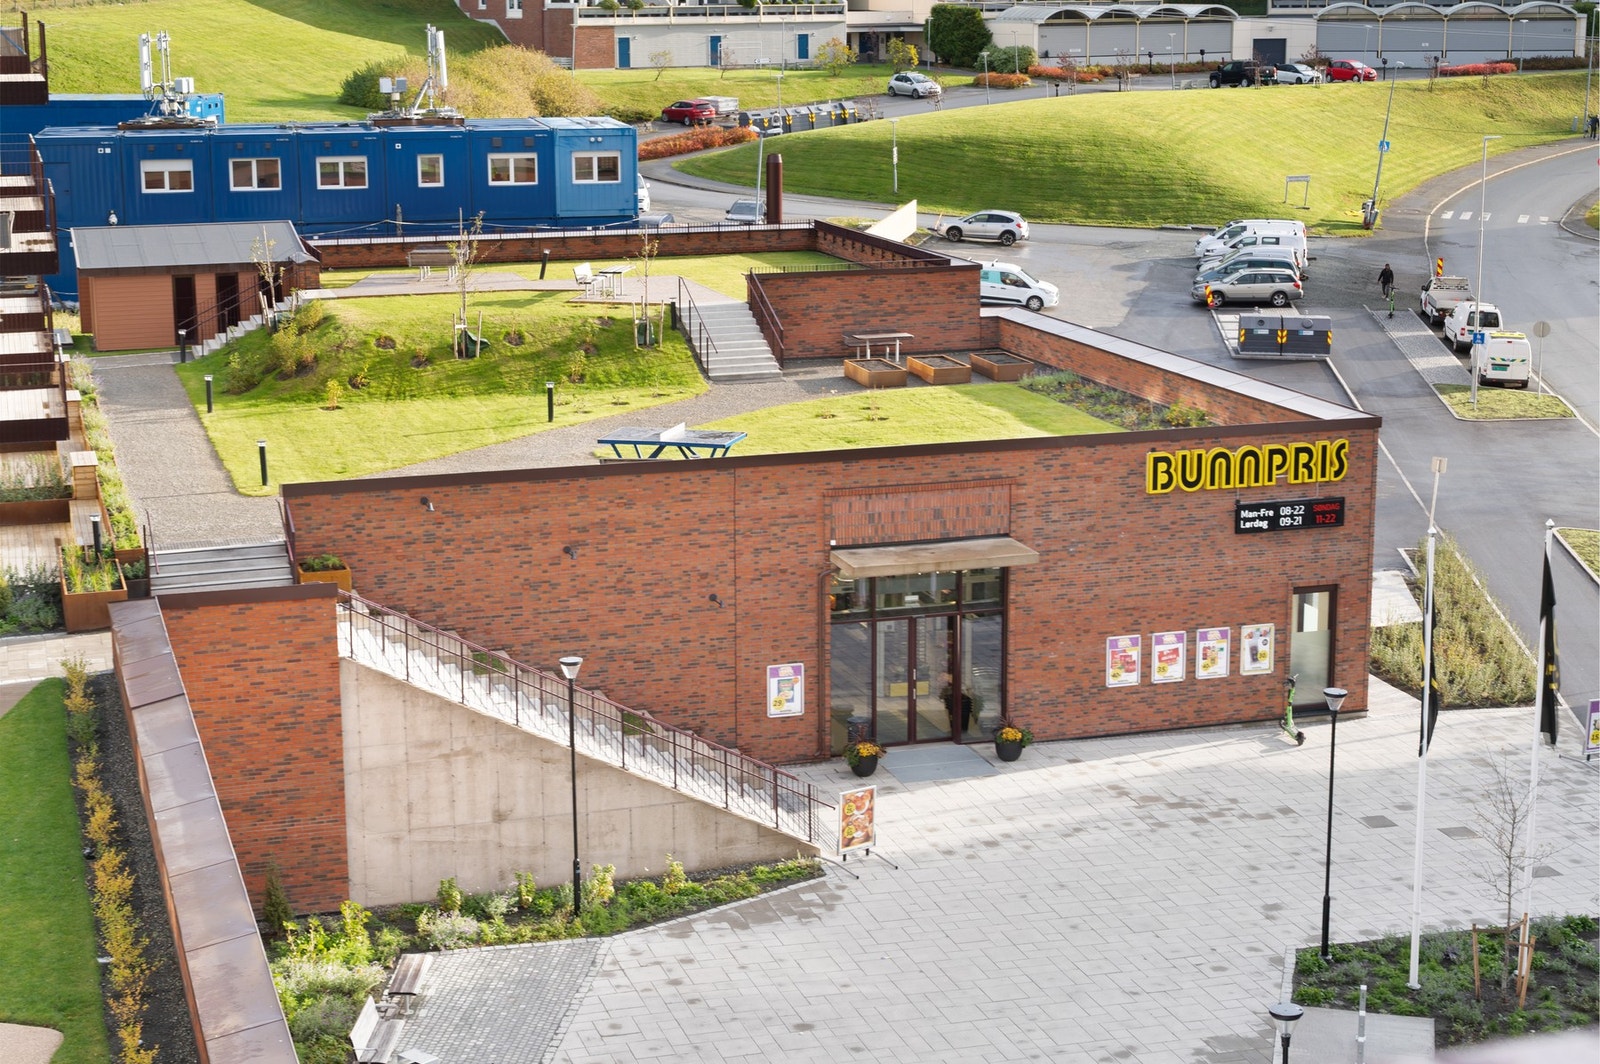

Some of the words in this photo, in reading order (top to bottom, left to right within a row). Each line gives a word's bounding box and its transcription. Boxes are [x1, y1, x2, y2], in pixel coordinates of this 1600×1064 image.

[1240, 508, 1275, 519] Man-Fre
[1279, 505, 1305, 516] 08-22
[1315, 513, 1337, 524] 11-22
[1240, 519, 1269, 529] Lørdag
[1279, 516, 1303, 527] 09-21
